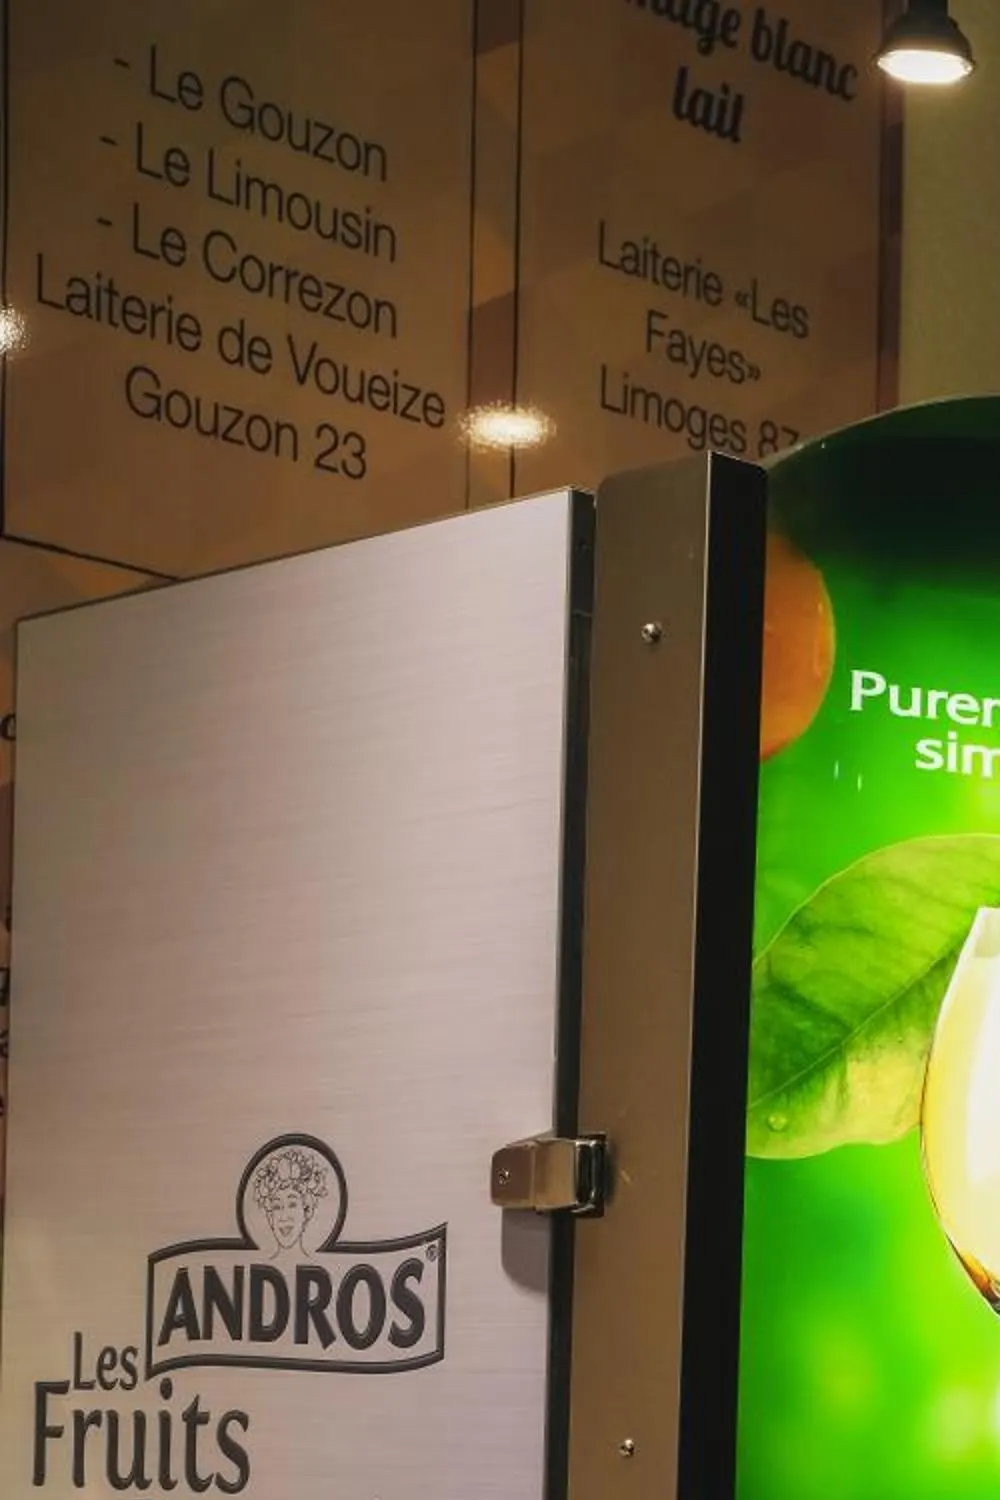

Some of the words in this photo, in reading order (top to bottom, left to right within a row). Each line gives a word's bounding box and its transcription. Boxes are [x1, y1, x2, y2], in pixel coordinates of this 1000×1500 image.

[149, 44, 204, 111] Le
[220, 75, 388, 182] Gouzon
[751, 8, 857, 102] blanc
[136, 121, 191, 188] Le
[207, 147, 398, 264] Limousin
[133, 202, 187, 268] Le
[203, 229, 398, 338] Correzon
[598, 218, 724, 307] Laiterie
[36, 253, 203, 353] Laiterie
[218, 319, 273, 376] de
[287, 333, 447, 429] Voueize
[124, 364, 299, 462] Gouzon
[313, 421, 368, 480] 23
[599, 364, 748, 453] Limoges
[72, 1330, 139, 1392] Les
[157, 1257, 426, 1351] ANDROS
[32, 1376, 252, 1494] Fruits
